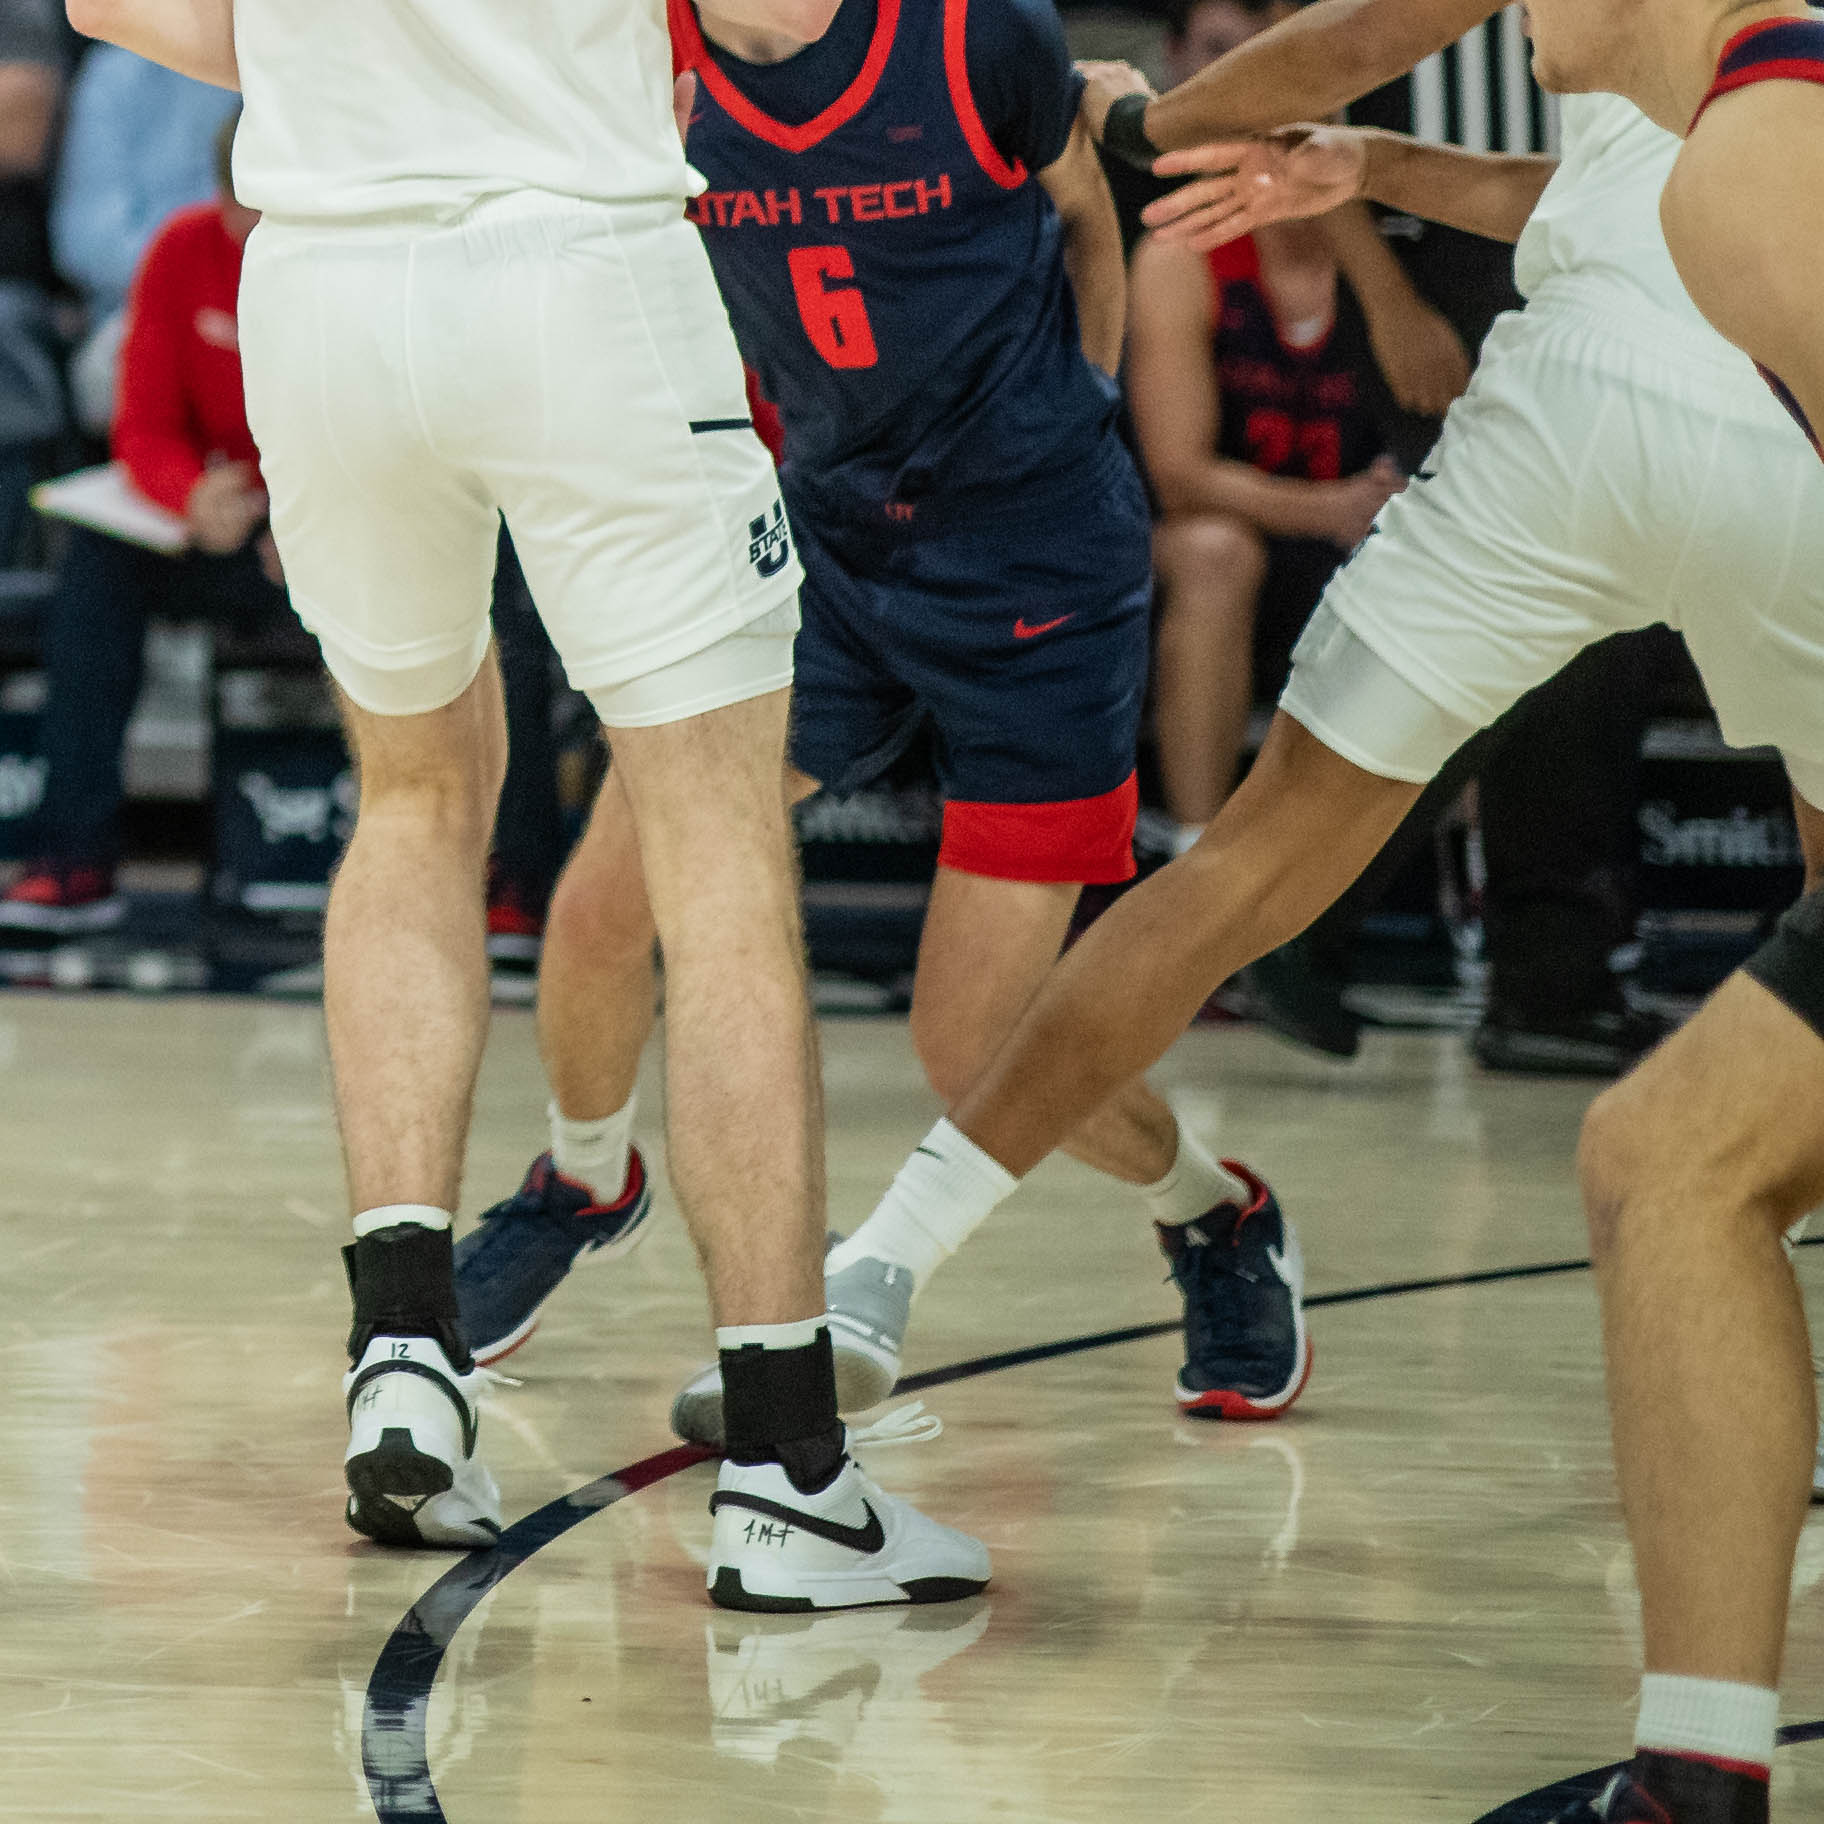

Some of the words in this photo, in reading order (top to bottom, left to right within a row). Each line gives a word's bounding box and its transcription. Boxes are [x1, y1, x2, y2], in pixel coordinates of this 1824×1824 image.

[814, 173, 953, 224] TECH
[787, 245, 879, 369] 6
[390, 1342, 412, 1360] 12
